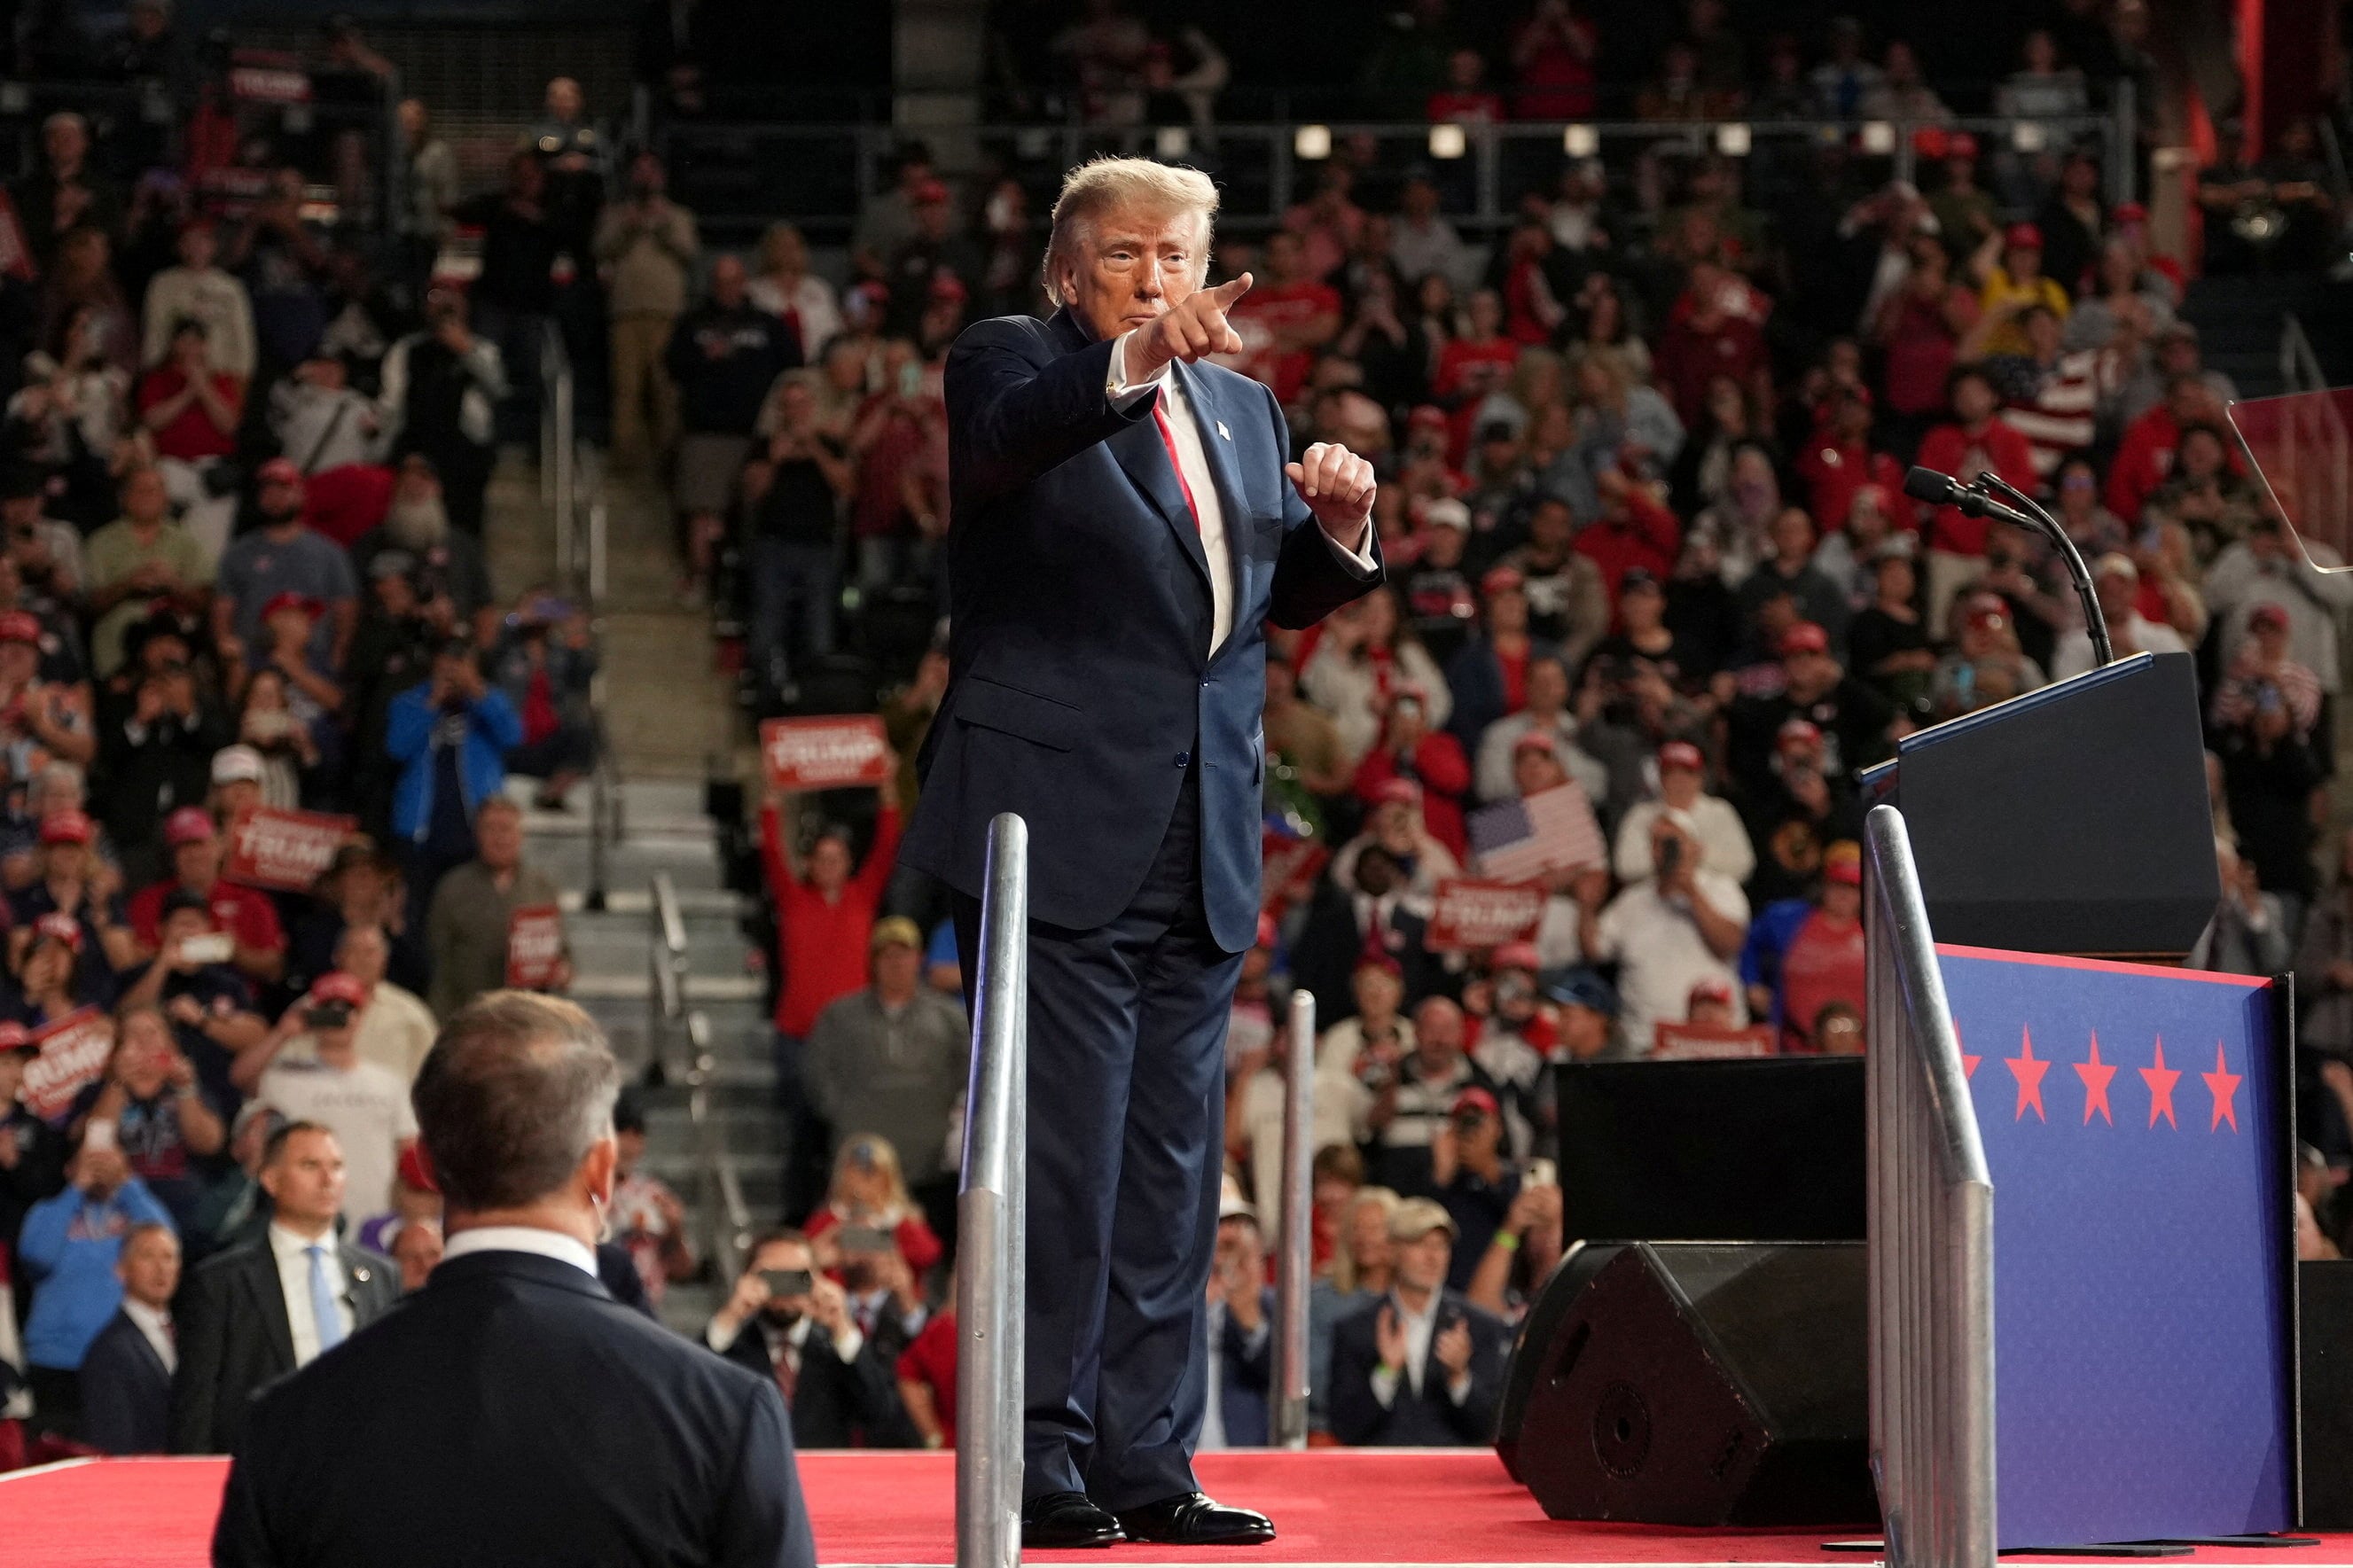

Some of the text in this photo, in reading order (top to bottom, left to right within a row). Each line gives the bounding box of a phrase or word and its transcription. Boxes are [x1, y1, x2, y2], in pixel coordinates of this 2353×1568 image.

[768, 736, 885, 770] TRUMP
[235, 824, 334, 868] TRUM
[1436, 898, 1541, 929] TRUMP
